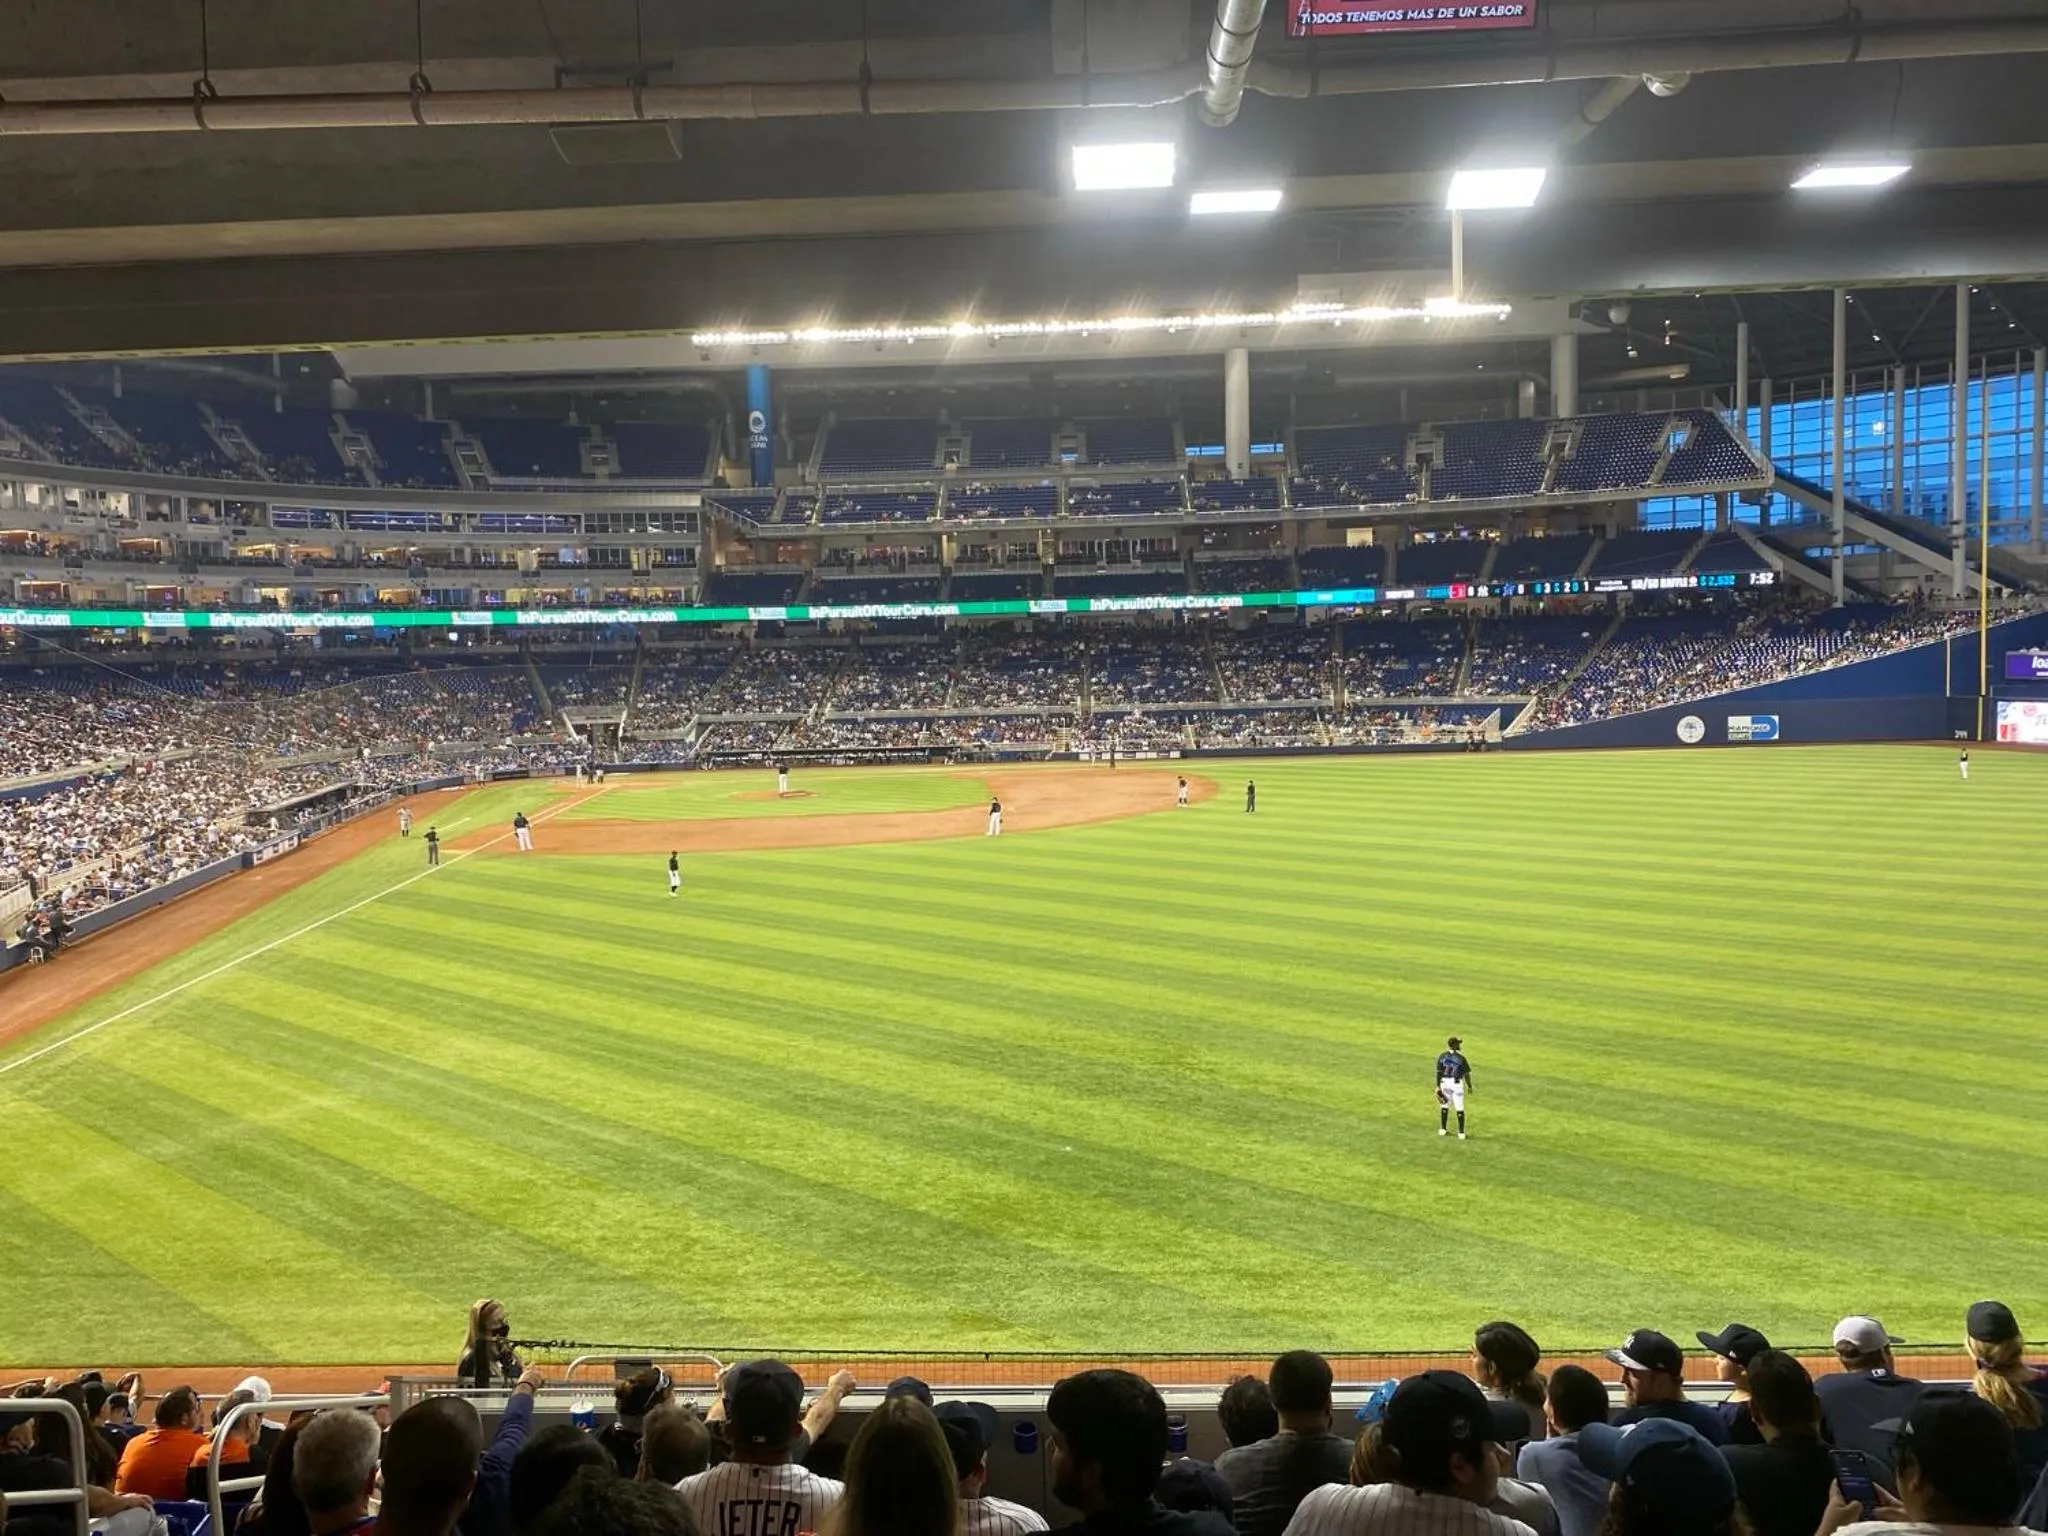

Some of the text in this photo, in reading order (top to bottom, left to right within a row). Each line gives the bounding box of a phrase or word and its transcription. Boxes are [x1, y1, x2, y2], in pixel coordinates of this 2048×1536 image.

[1347, 10, 1403, 22] TENEMOS
[1407, 9, 1433, 20] MAS
[1438, 8, 1454, 18] DE
[1459, 7, 1477, 17] UN
[1481, 5, 1523, 16] SABOR
[1750, 573, 1774, 585] 7:52
[1090, 595, 1243, 611] InPursuitOfYourCure.com
[517, 609, 678, 624] InPursuitOfYourCure.com
[809, 604, 960, 618] InPursuitOfYourCure.com
[209, 612, 374, 626] InPursuitOfYourCure.com
[710, 1499, 802, 1536] JETER
